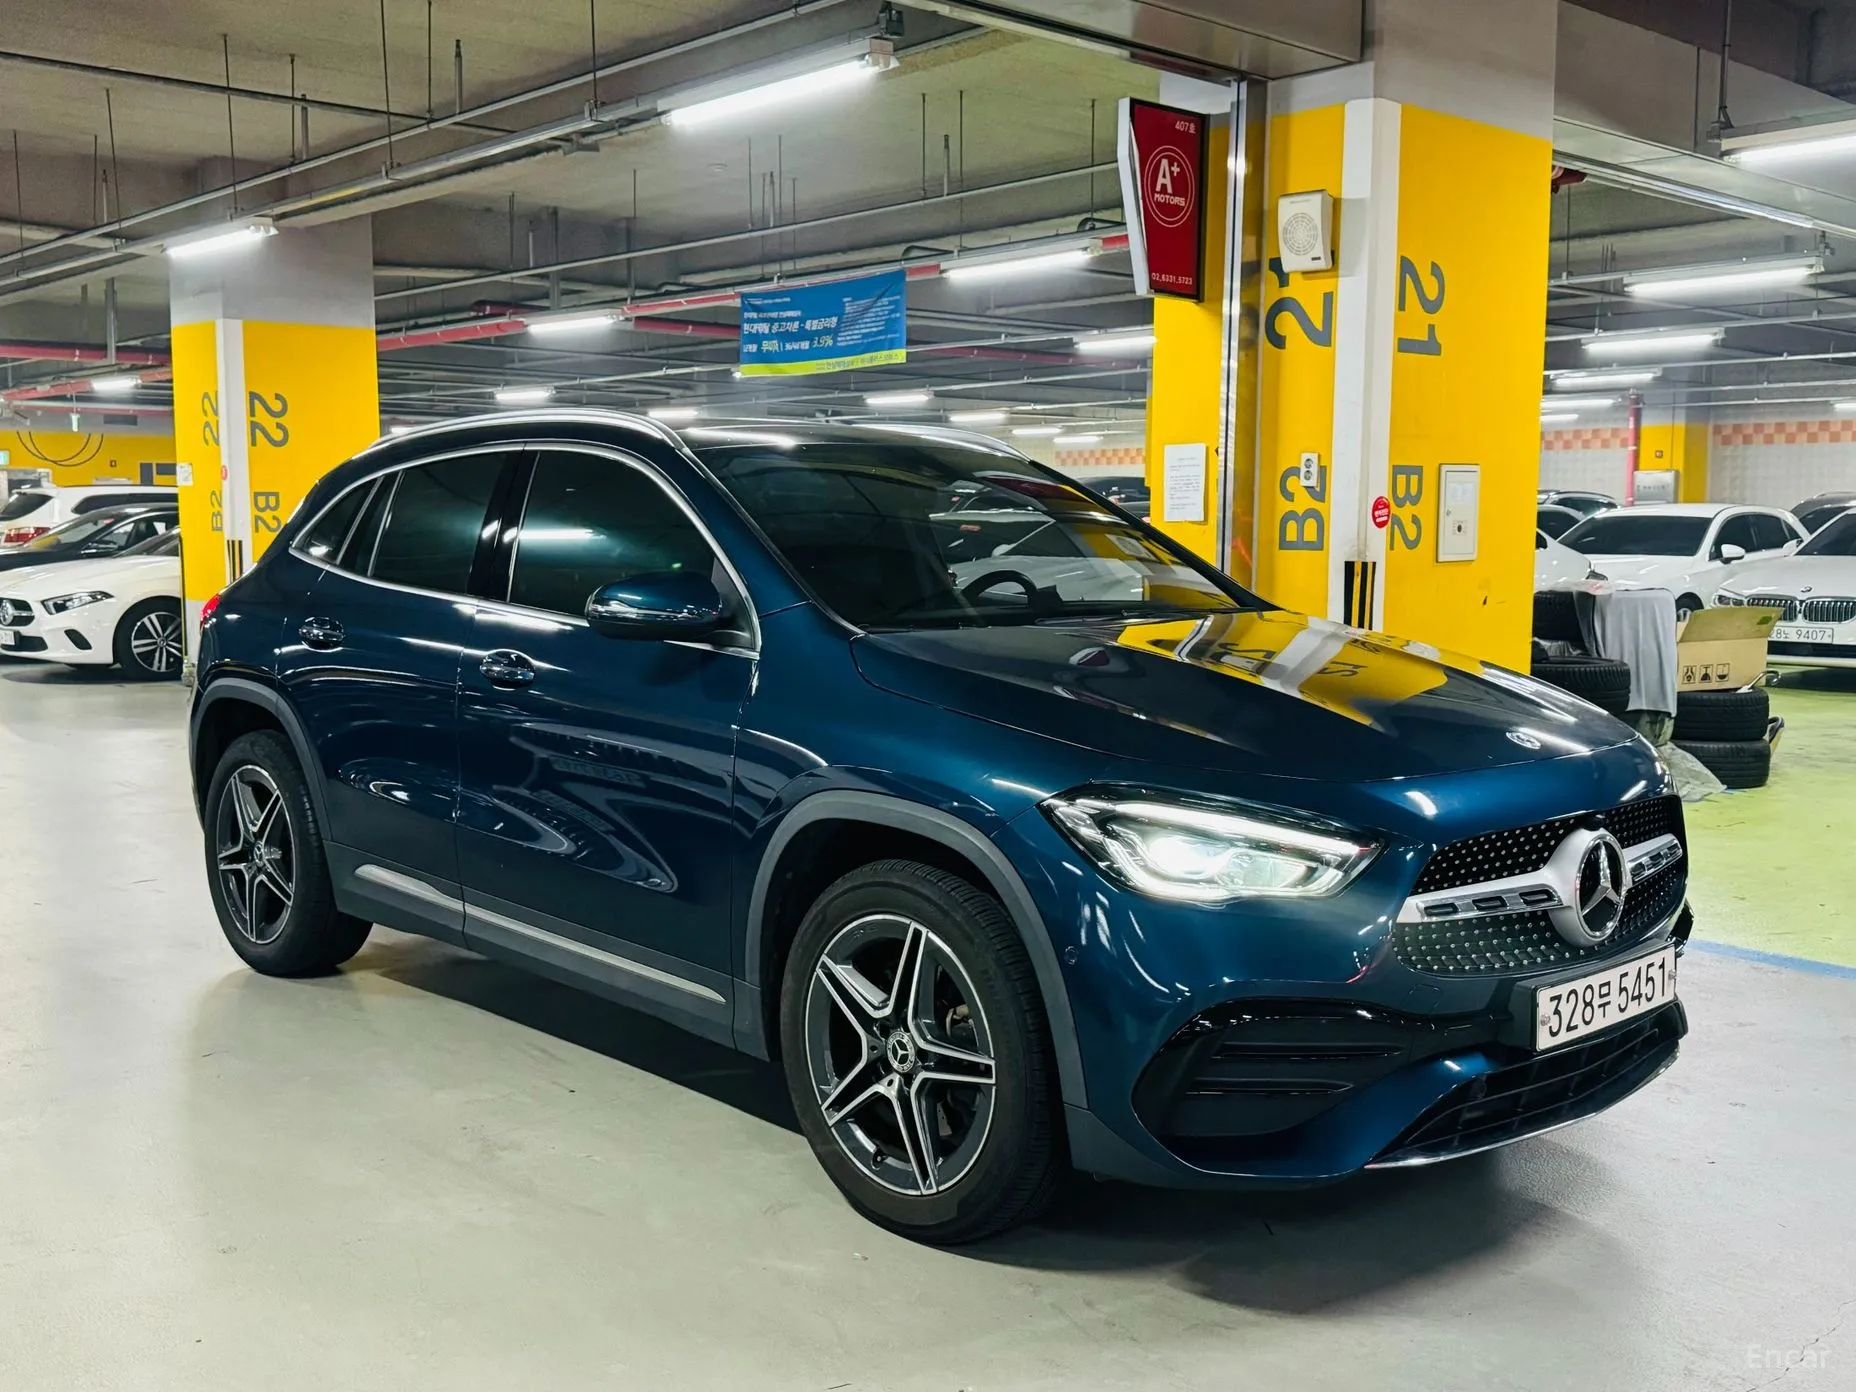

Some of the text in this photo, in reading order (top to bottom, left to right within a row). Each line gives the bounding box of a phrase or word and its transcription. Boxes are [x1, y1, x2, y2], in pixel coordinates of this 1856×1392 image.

[1154, 193, 1186, 206] MOTORS
[1155, 158, 1180, 193] A+
[1264, 250, 1335, 350] 2
[1397, 255, 1445, 356] 21
[812, 334, 834, 348] 3.9%
[249, 391, 290, 448] 22
[253, 491, 283, 534] B2
[1278, 464, 1327, 551] B2
[1390, 464, 1423, 551] B2
[1795, 629, 1827, 640] 9407
[1548, 957, 1668, 1038] 328무 5451
